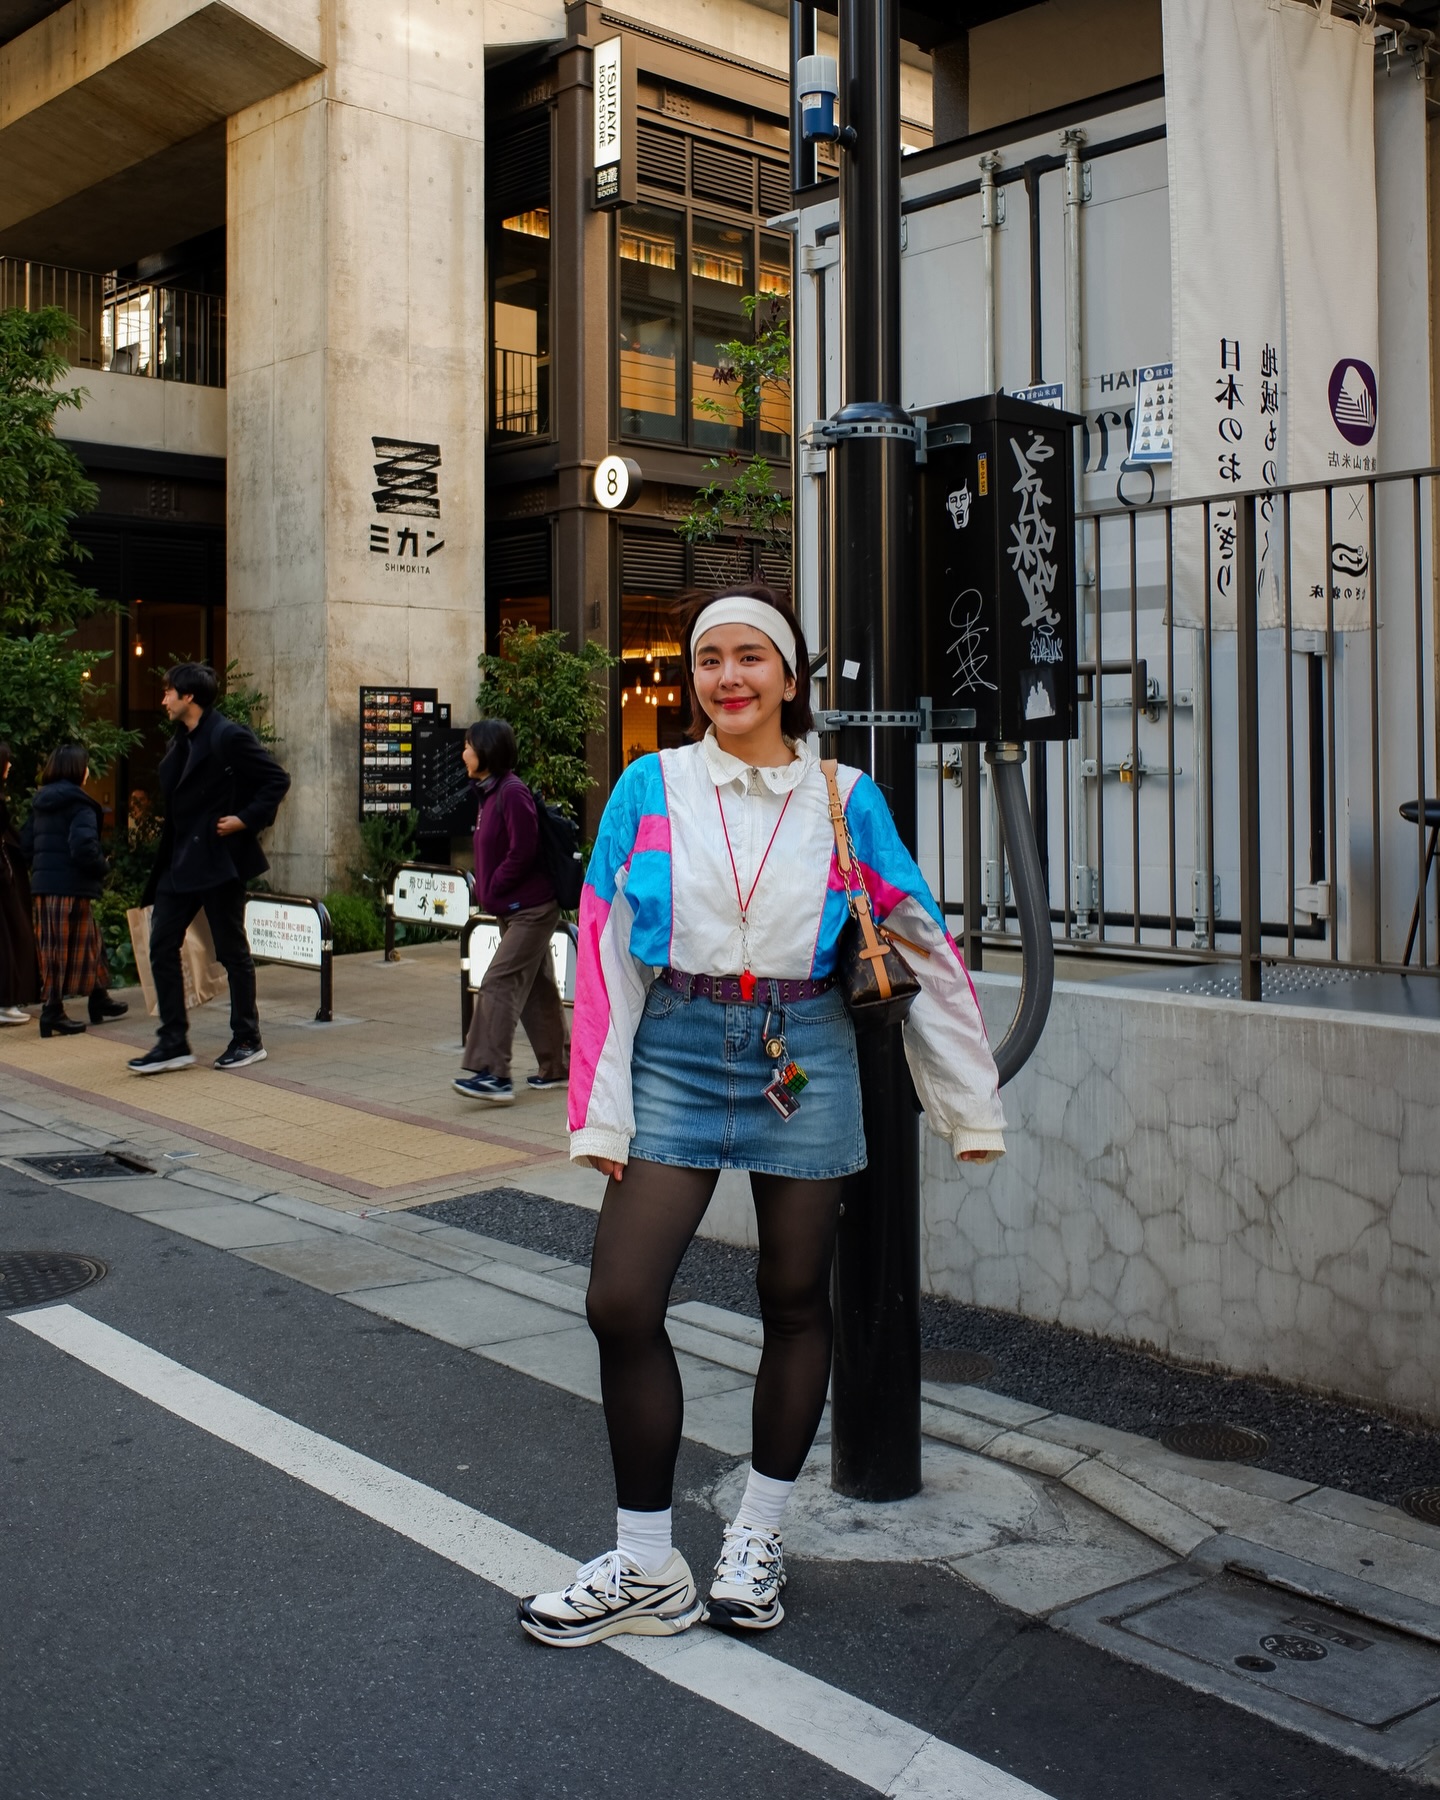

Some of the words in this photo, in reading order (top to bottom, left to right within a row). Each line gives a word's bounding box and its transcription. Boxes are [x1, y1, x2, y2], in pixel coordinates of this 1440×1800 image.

[599, 64, 607, 149] BOOKSTORE
[607, 60, 617, 145] TSUTAYA
[597, 186, 618, 198] BOOKS
[607, 468, 618, 496] 8
[370, 524, 445, 557] ミカン
[385, 562, 431, 574] SHIMOKITA
